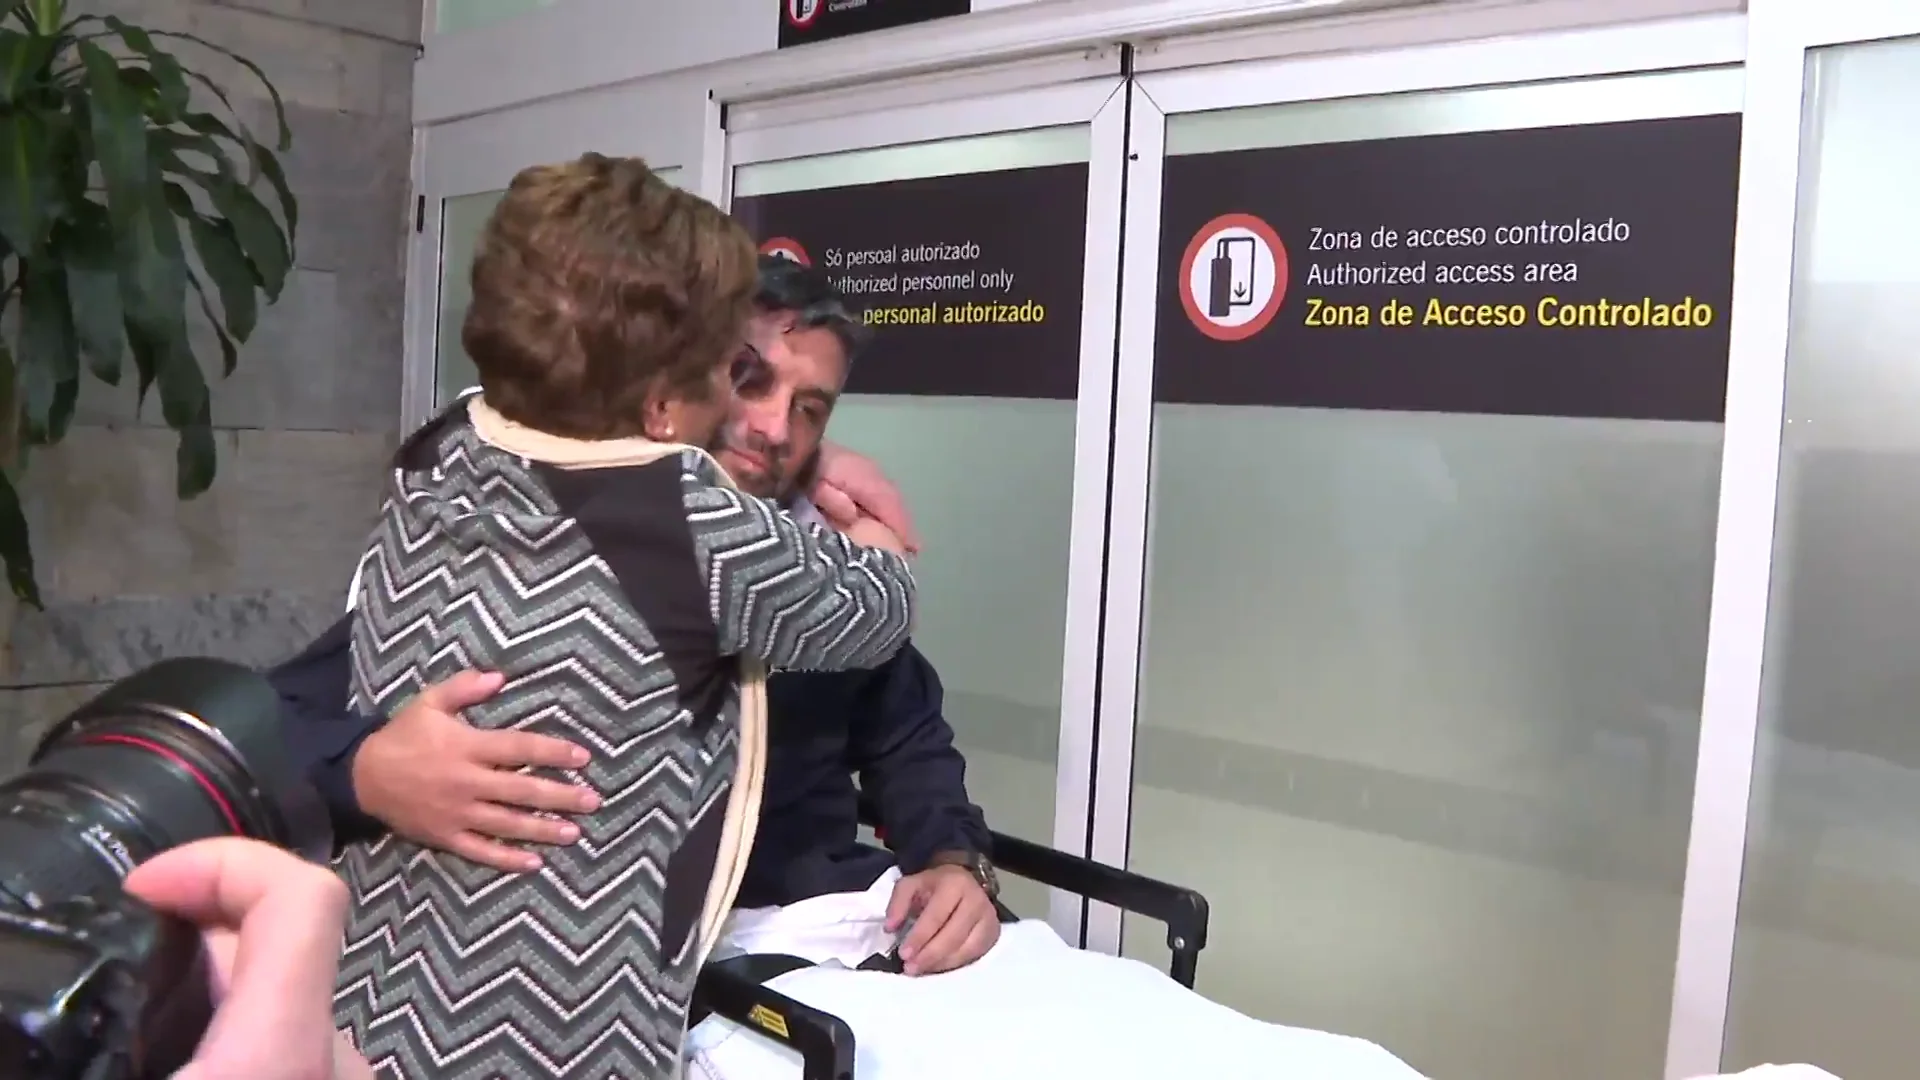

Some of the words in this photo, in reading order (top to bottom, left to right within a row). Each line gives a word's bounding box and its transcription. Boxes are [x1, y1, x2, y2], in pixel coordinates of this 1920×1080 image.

[1309, 228, 1361, 250] Zona
[1371, 226, 1397, 248] de
[1407, 228, 1486, 247] acceso
[1495, 218, 1629, 244] controlado
[826, 248, 842, 267] Só
[847, 245, 896, 269] persoal
[902, 241, 979, 262] autorizado
[903, 270, 974, 295] personnel
[980, 269, 1013, 292] only
[1307, 260, 1425, 285] Authorized
[1436, 264, 1514, 283] access
[1524, 264, 1577, 281] area
[864, 302, 936, 326] personal
[943, 300, 1044, 323] autorizado
[1305, 299, 1368, 325] Zona
[1381, 300, 1412, 325] de
[1423, 299, 1525, 325] Acceso
[1538, 296, 1711, 326] Controlado
